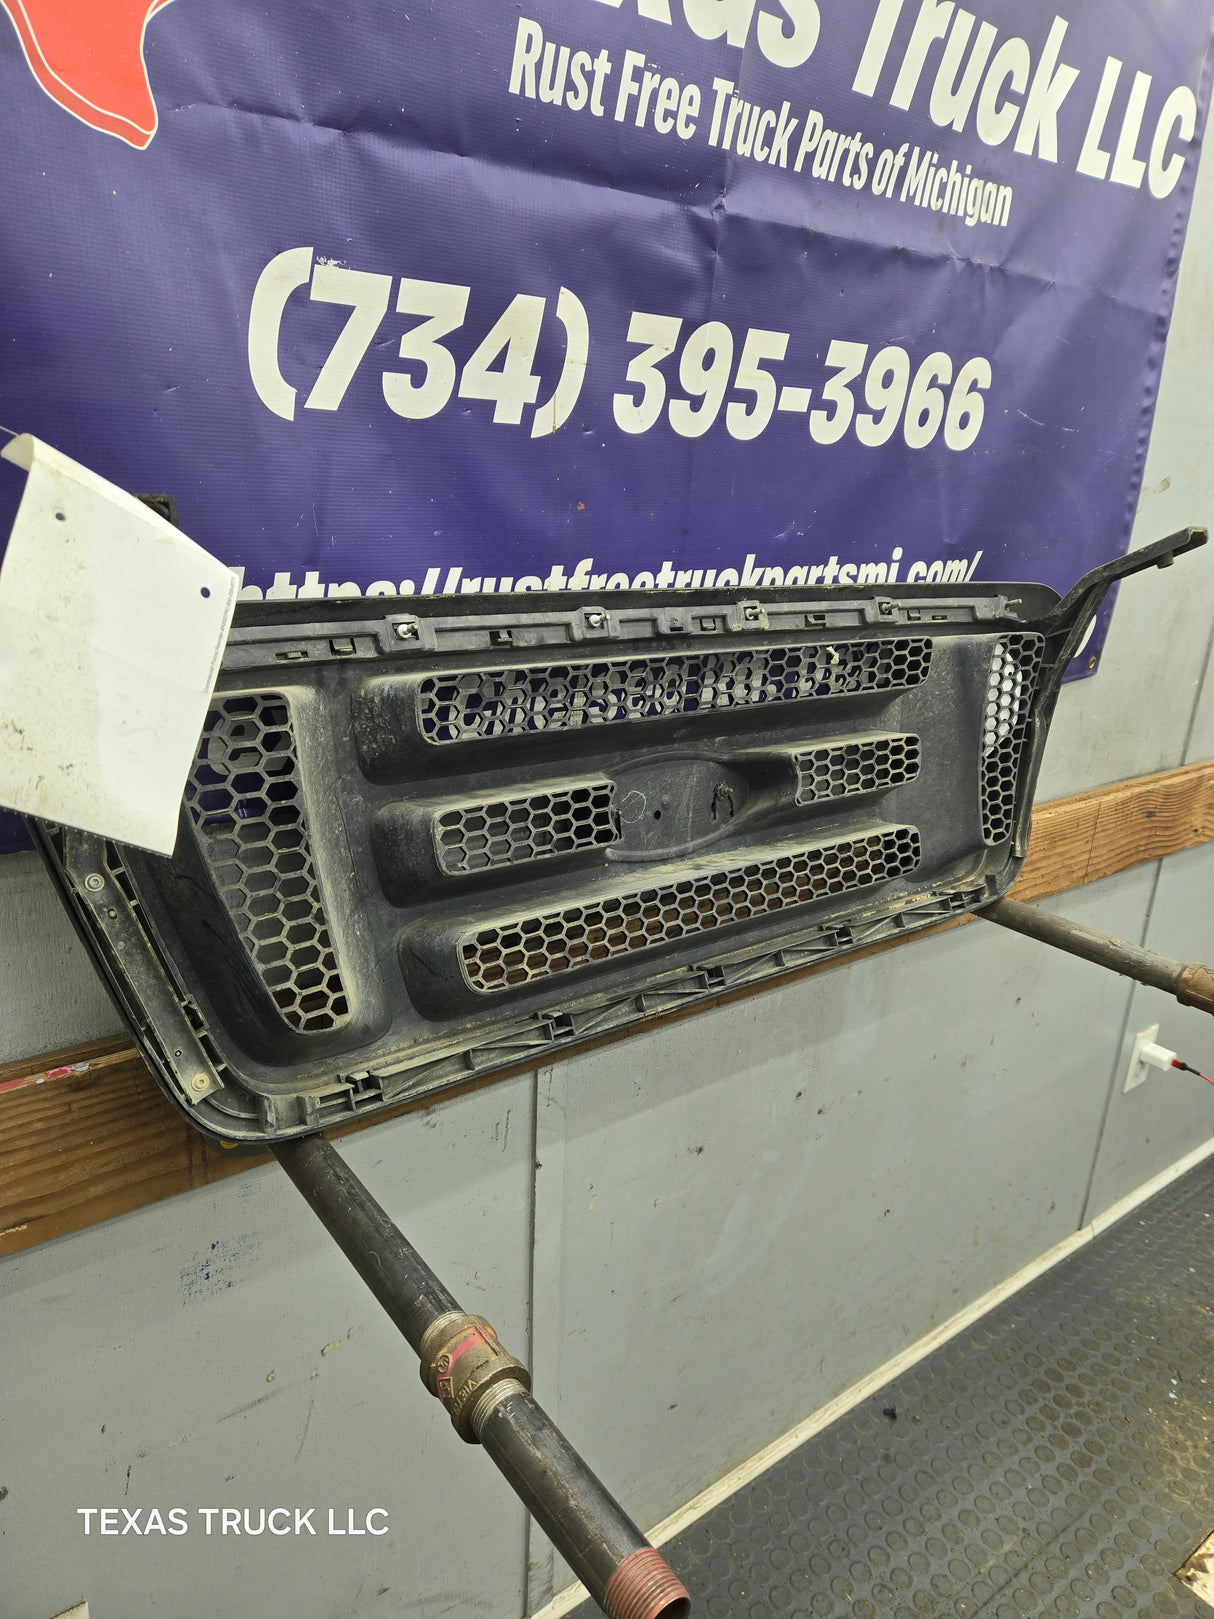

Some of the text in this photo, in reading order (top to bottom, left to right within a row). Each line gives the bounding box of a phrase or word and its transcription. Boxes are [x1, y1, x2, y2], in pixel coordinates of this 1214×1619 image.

[508, 16, 612, 117] Rust
[614, 49, 702, 139] Free
[708, 76, 799, 168] Truck
[793, 109, 874, 190] Parts
[871, 142, 910, 198] of
[899, 145, 1013, 227] Michigan
[1077, 56, 1197, 199] LLC
[247, 246, 992, 451] (734) 395-3966
